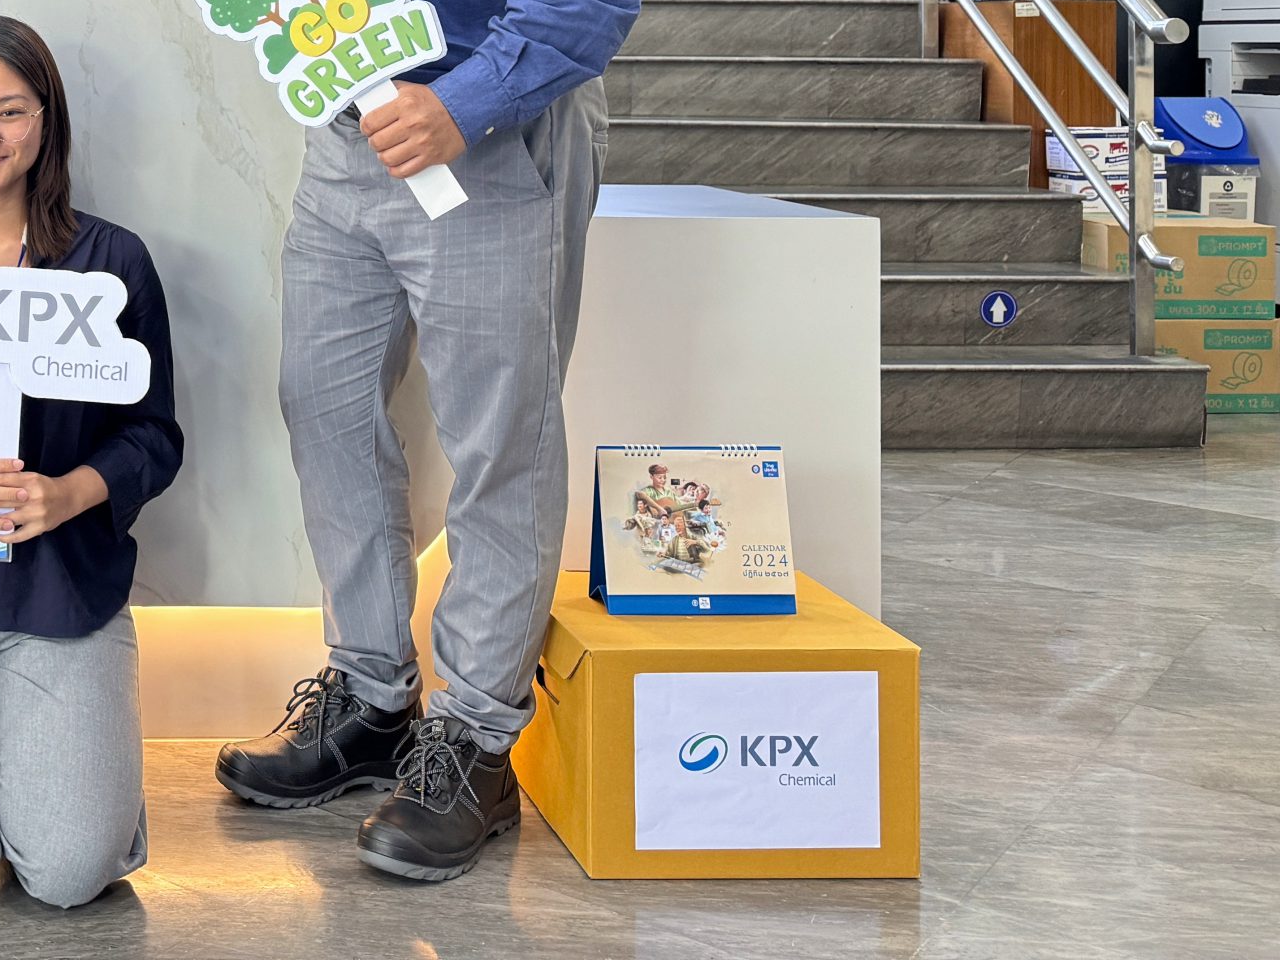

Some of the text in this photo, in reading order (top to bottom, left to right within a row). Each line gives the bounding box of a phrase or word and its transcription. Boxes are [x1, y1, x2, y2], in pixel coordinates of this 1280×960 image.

[287, 9, 434, 118] GREEN
[1218, 242, 1264, 251] PROMPT
[1223, 335, 1269, 344] PROMPT
[31, 355, 128, 382] Chemical
[1206, 399, 1222, 409] 00
[741, 544, 786, 552] CALENDAR
[742, 553, 789, 567] 2024
[742, 570, 763, 578] ปฏิทิน
[740, 735, 819, 767] KPX
[778, 773, 836, 786] Chemical
